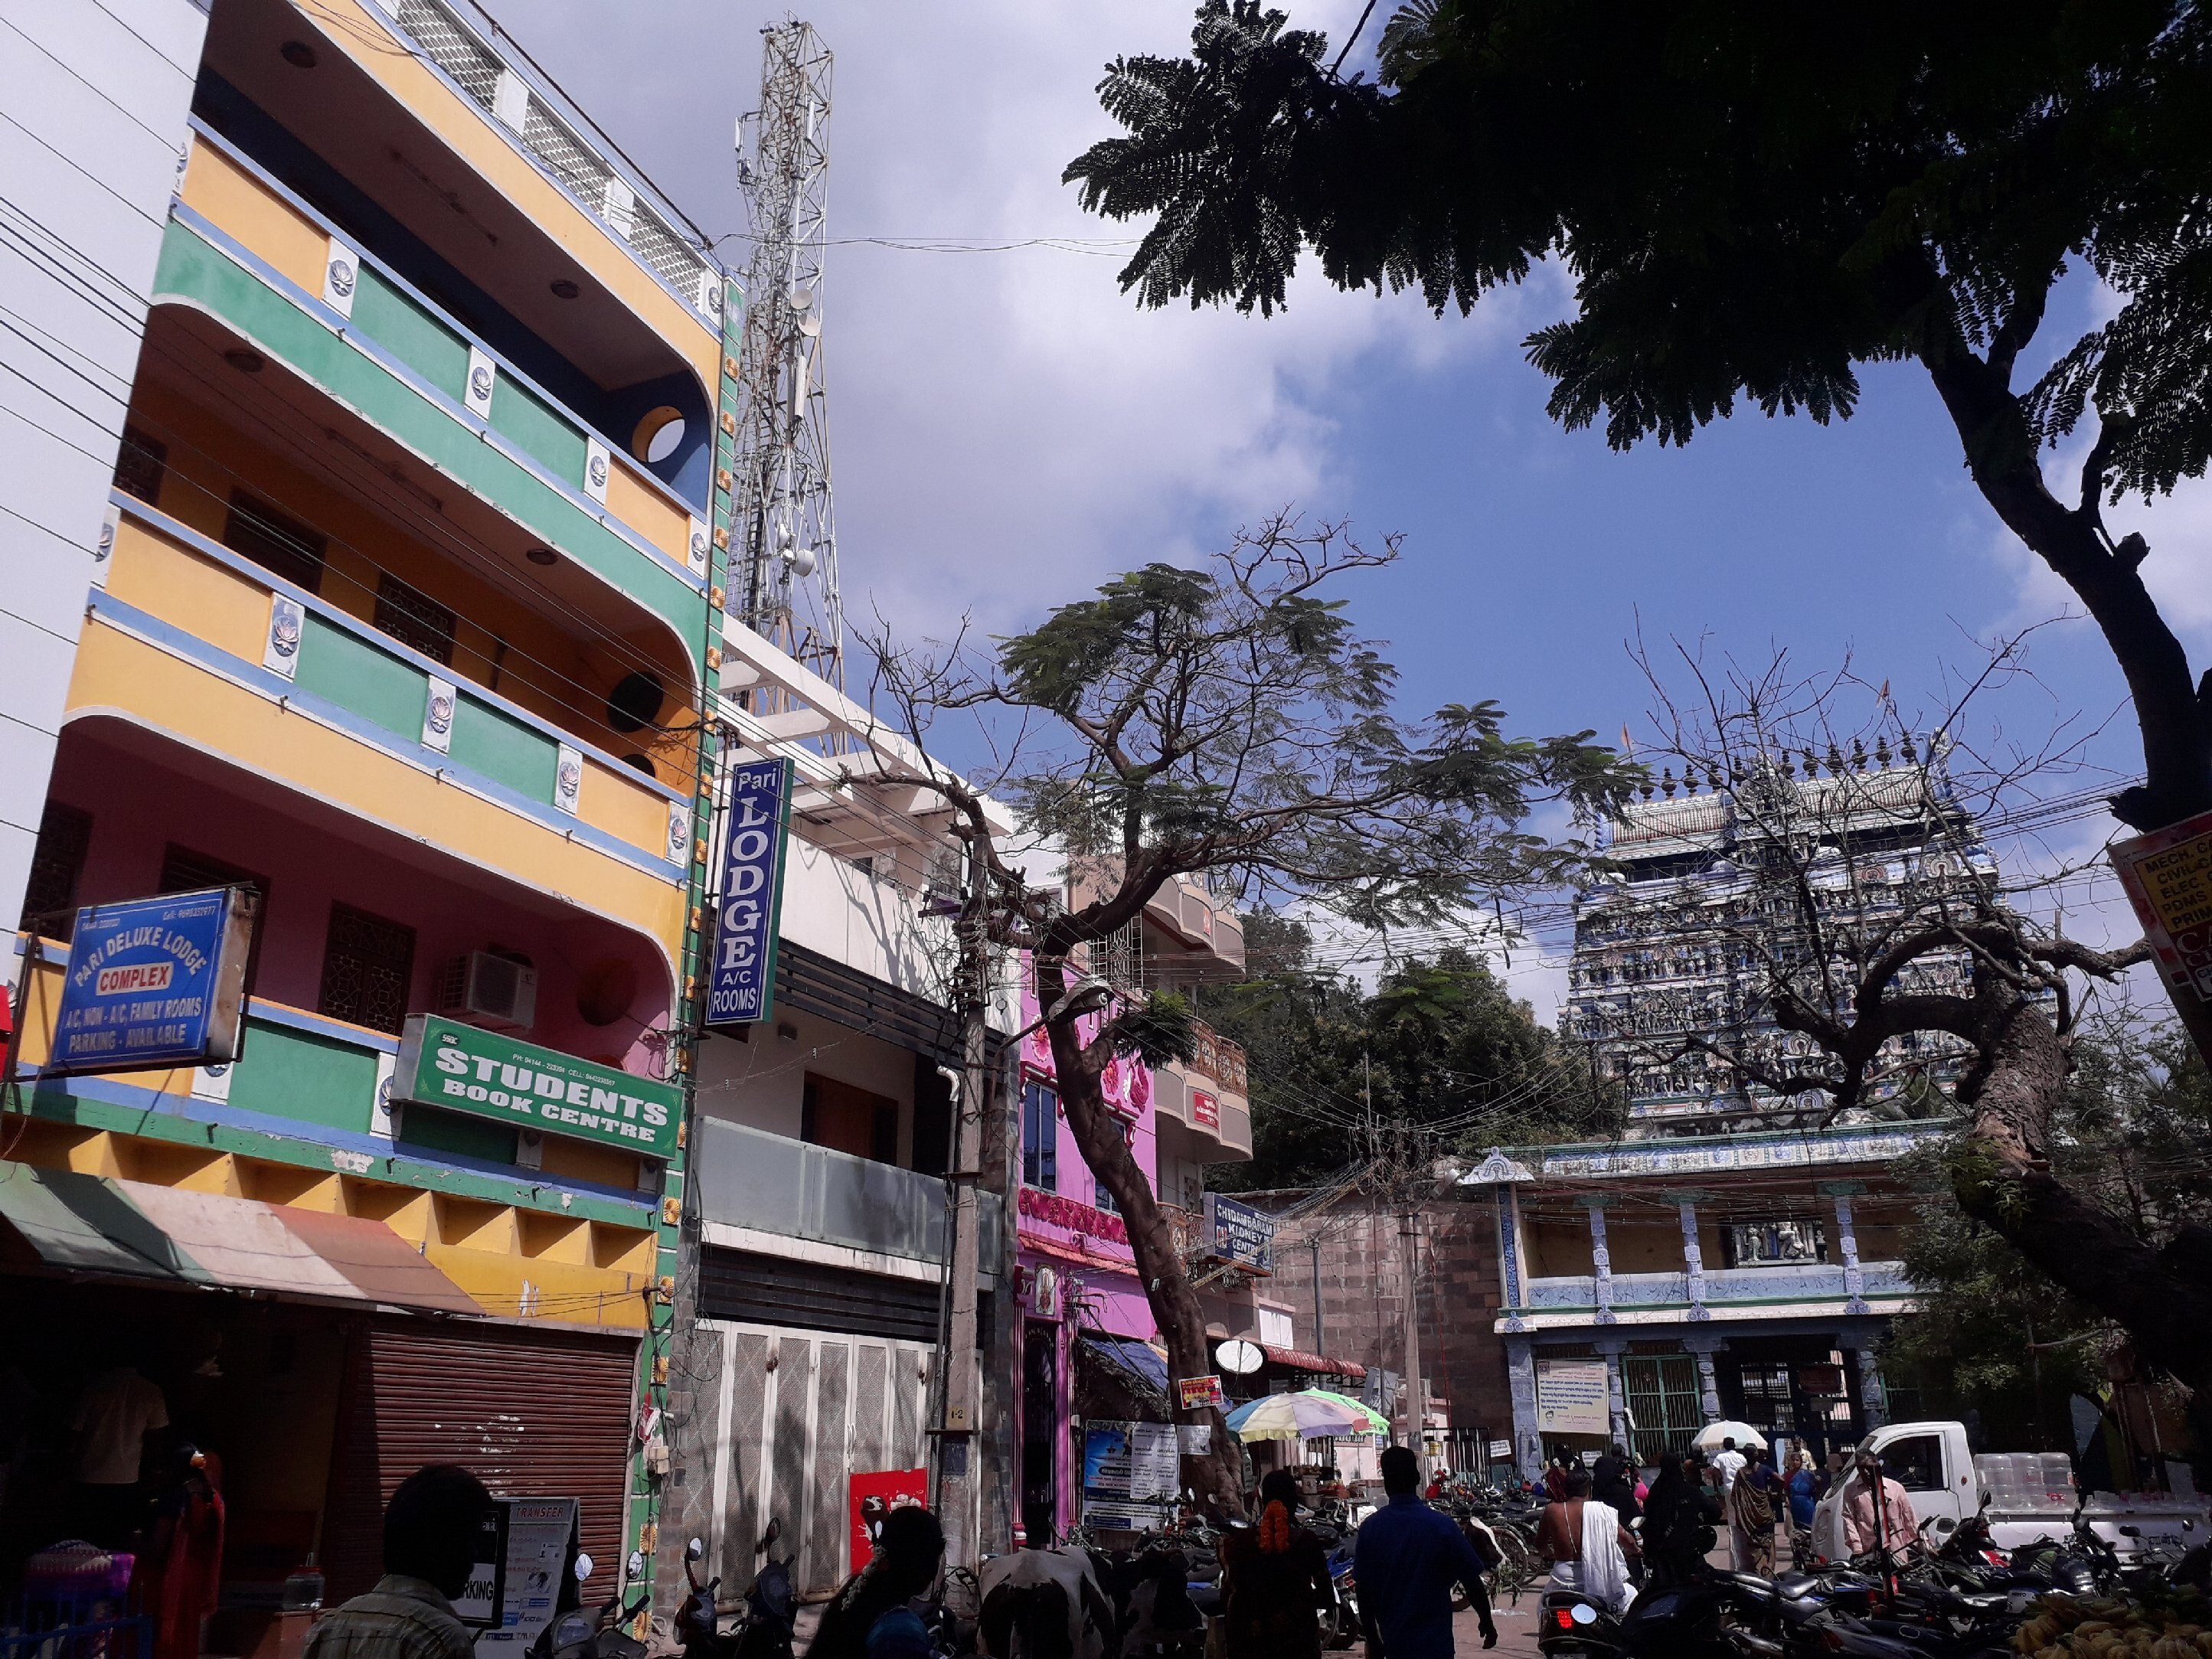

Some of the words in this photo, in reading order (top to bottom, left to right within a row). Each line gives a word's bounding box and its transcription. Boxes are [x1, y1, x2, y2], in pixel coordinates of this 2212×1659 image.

[737, 768, 776, 792] Pari
[721, 796, 769, 969] LODGE
[75, 947, 104, 987] PARI
[106, 927, 164, 957] DELUXE
[162, 930, 207, 976] LODGE
[100, 965, 170, 992] COMPLEX
[721, 970, 752, 986] A/C
[130, 1001, 165, 1022] FAMILY
[164, 997, 202, 1018] ROOMS
[712, 987, 756, 1013] ROOMS
[69, 1030, 116, 1053] PARKING
[126, 1023, 187, 1048] AVAILABLE
[435, 1047, 668, 1126] STUDENTS
[443, 1078, 533, 1114] BOOK
[541, 1102, 656, 1143] CENTRE
[1217, 1203, 1273, 1236] CHIDAMBARAM
[1228, 1223, 1263, 1244] KIDNEY
[516, 1506, 564, 1519] TRANSFER
[463, 1579, 494, 1602] RKING
